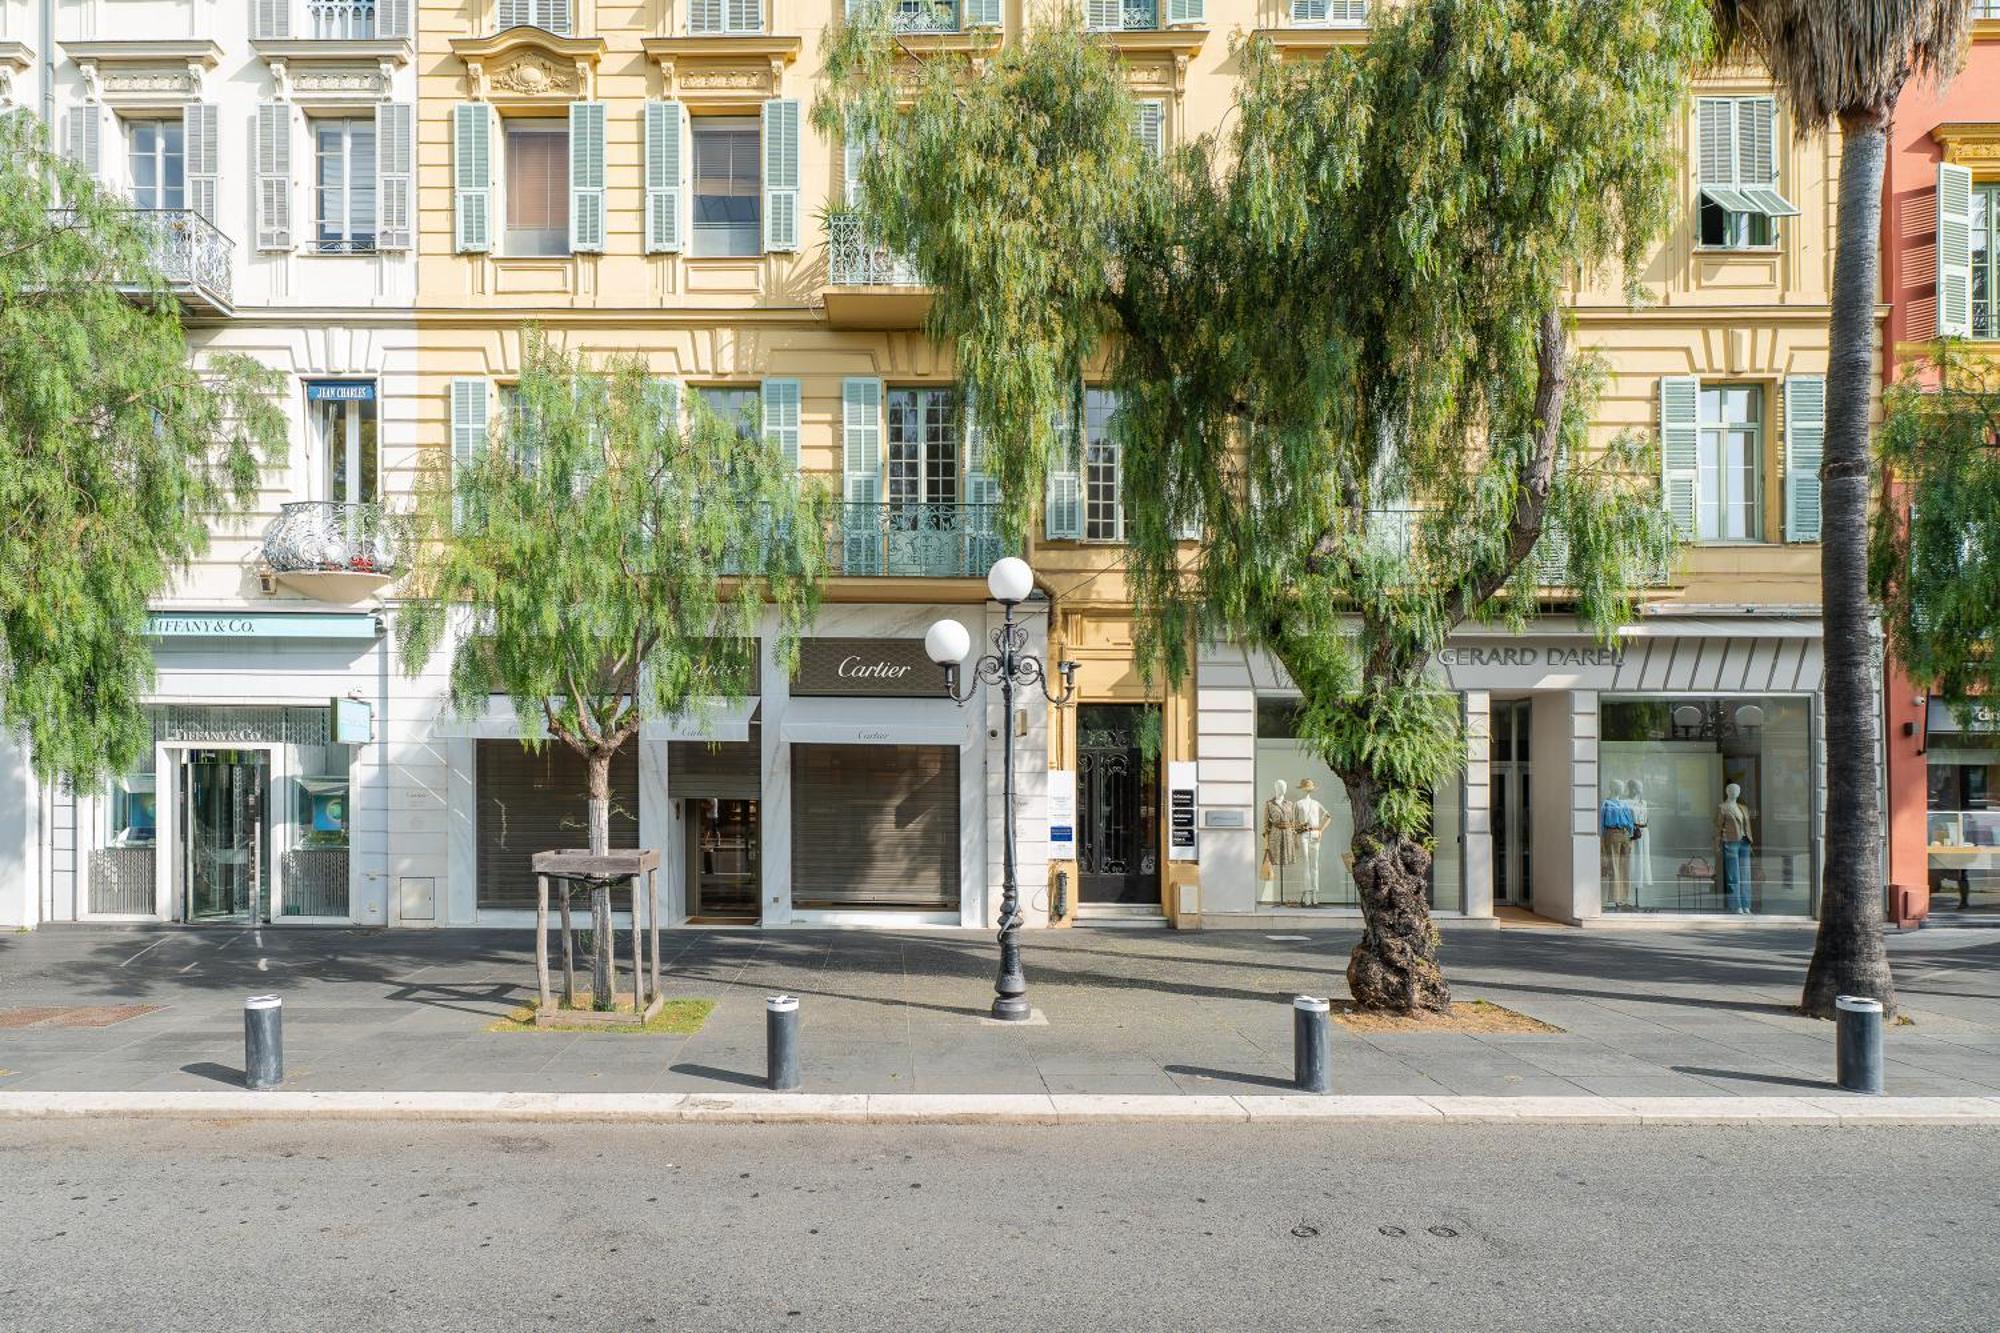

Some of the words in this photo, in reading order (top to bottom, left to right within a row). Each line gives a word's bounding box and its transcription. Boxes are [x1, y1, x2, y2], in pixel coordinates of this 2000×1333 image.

[317, 386, 336, 398] JEAN
[336, 386, 367, 398] CHARLES
[213, 619, 225, 632] &
[1437, 648, 1538, 666] GERARD
[838, 655, 912, 678] Cartier
